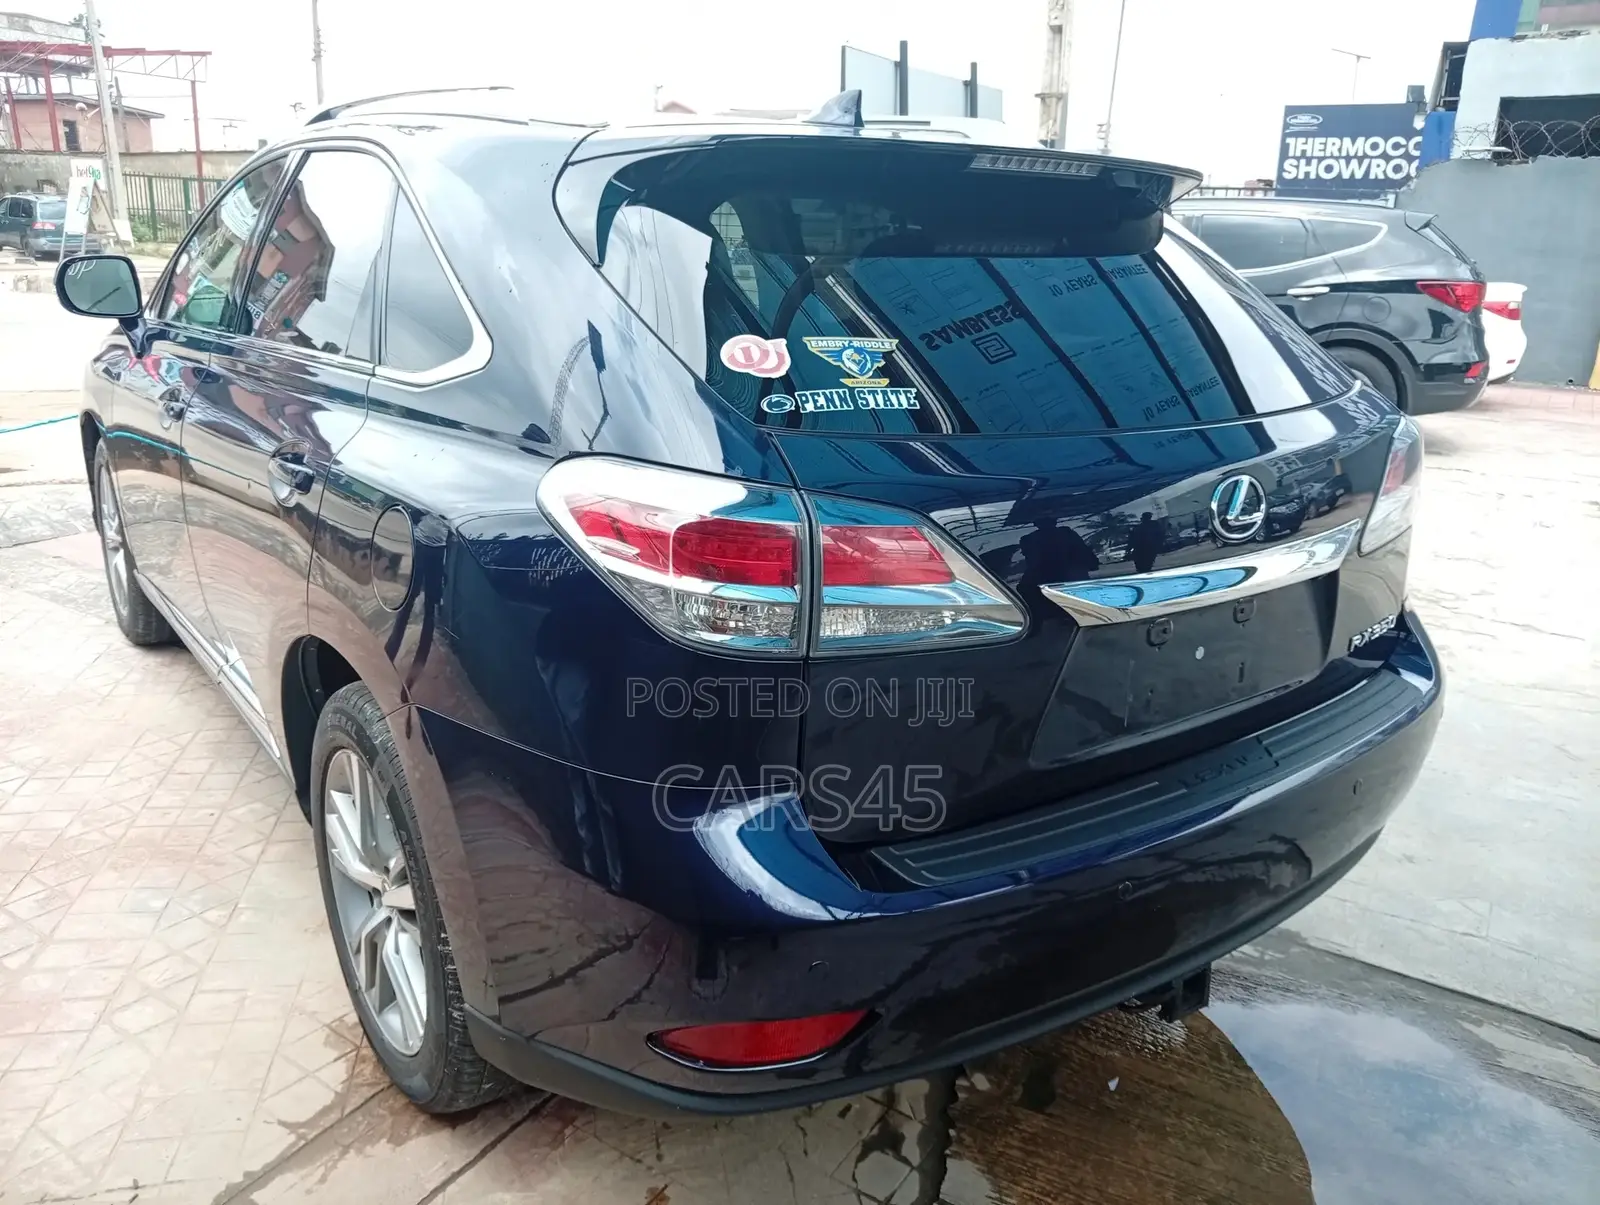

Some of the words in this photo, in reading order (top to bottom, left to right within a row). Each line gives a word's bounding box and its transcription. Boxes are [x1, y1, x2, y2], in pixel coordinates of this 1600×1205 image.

[810, 340, 891, 349] EMBRY-RIDDLE
[797, 390, 852, 412] PENN
[857, 389, 918, 410] STATE
